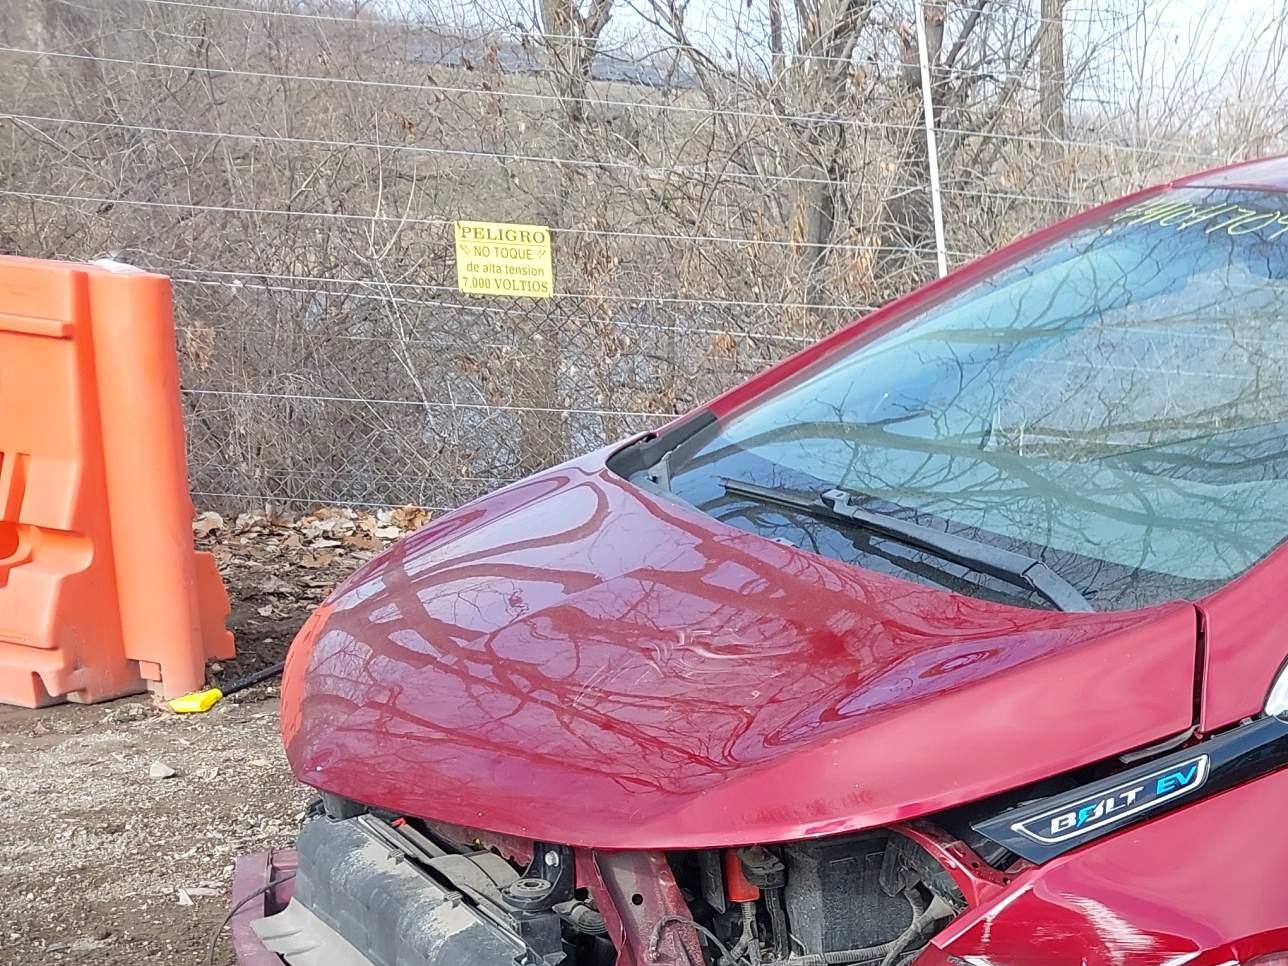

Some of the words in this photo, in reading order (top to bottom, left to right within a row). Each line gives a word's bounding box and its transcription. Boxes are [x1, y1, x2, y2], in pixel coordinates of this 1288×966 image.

[461, 226, 545, 243] PELIGRO
[474, 245, 490, 258] NO
[494, 247, 534, 260] TOQUE
[466, 261, 479, 273] de
[483, 263, 502, 274] alta
[505, 265, 545, 276] tension
[494, 278, 548, 293] VOLTIOS
[1050, 786, 1144, 835] BOLT
[1156, 766, 1197, 795] EV
